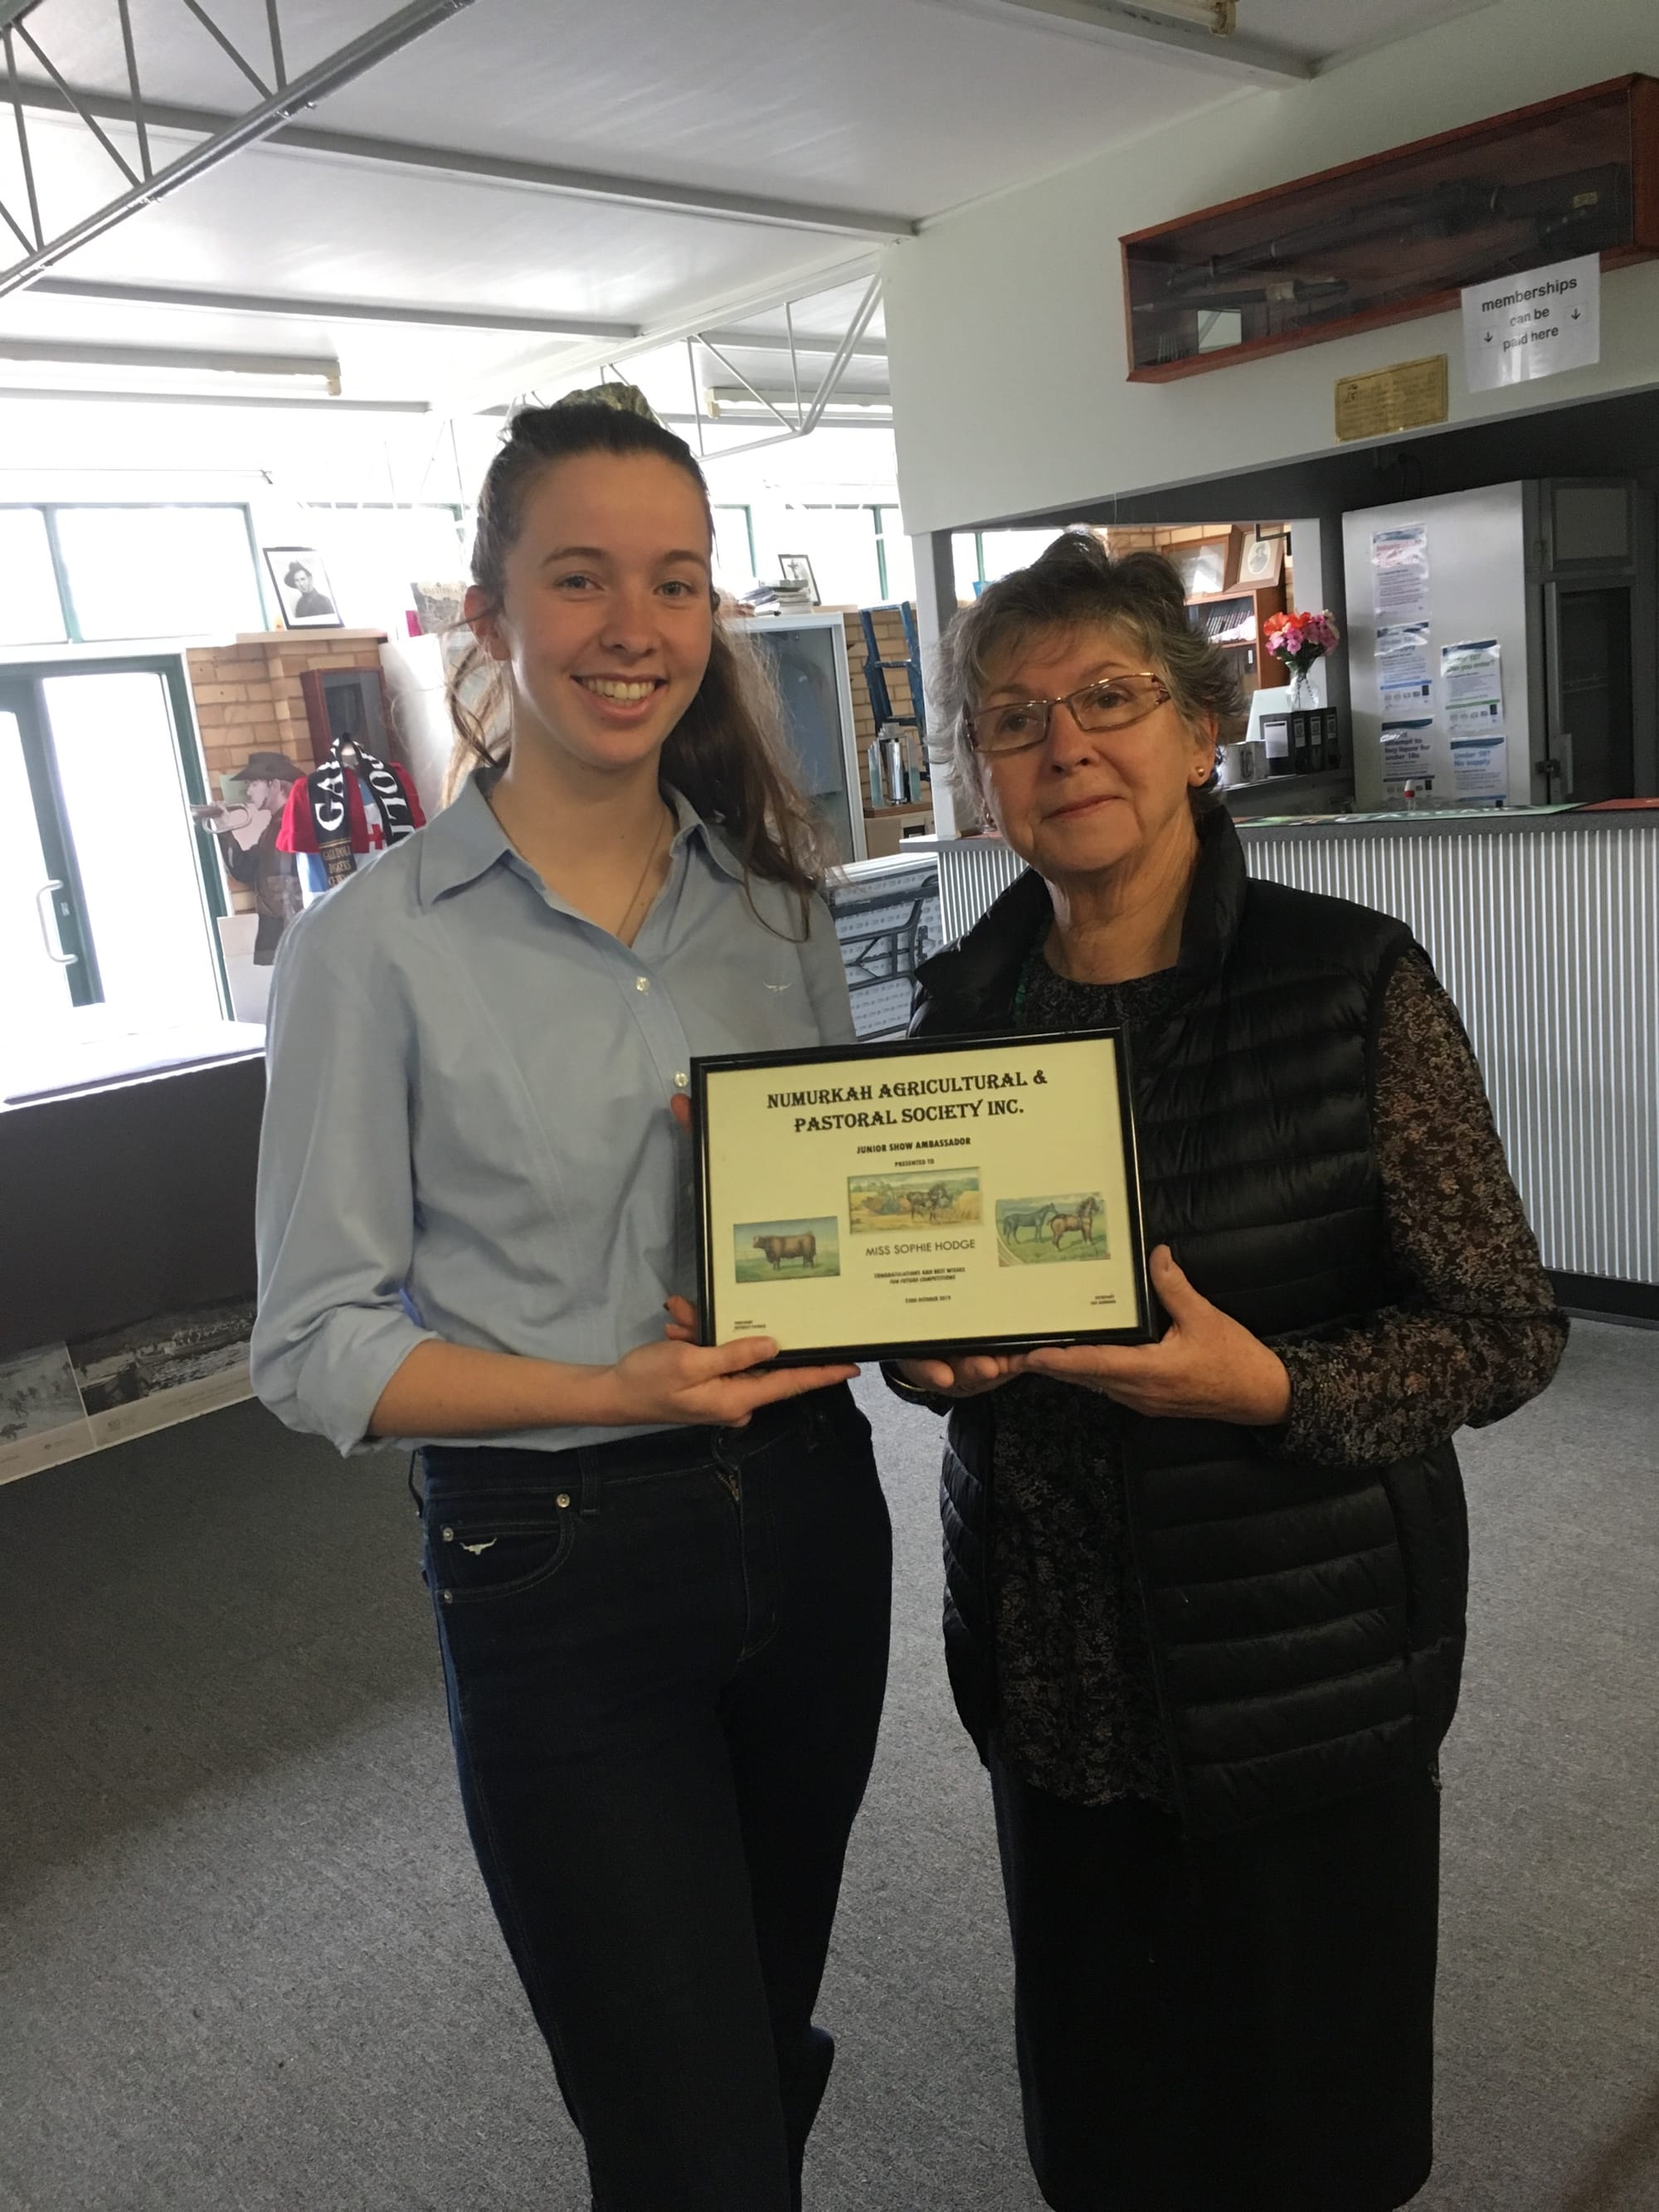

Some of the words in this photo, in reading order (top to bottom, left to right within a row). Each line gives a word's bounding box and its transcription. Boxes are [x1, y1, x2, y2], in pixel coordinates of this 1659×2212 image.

[1481, 278, 1578, 313] memberships
[1510, 313, 1531, 327] can
[1534, 308, 1550, 320] be
[1503, 333, 1529, 352] paid
[1530, 327, 1559, 342] here
[766, 1085, 873, 1109] NUMURKAH
[878, 1072, 1028, 1099] AGRICULTURAL
[1033, 1070, 1048, 1085] &
[794, 1110, 898, 1133] PASTORAL
[901, 1099, 984, 1123] SOCIETY
[988, 1099, 1024, 1116] INC.
[857, 1144, 887, 1154] JUNIOR
[888, 1141, 912, 1151] SHOW
[916, 1137, 971, 1149] AMBASSADOR
[894, 1159, 926, 1167] PRESENTED
[865, 1245, 891, 1257] MISS
[894, 1242, 932, 1254] SOPHIE
[935, 1239, 975, 1251] HODGE
